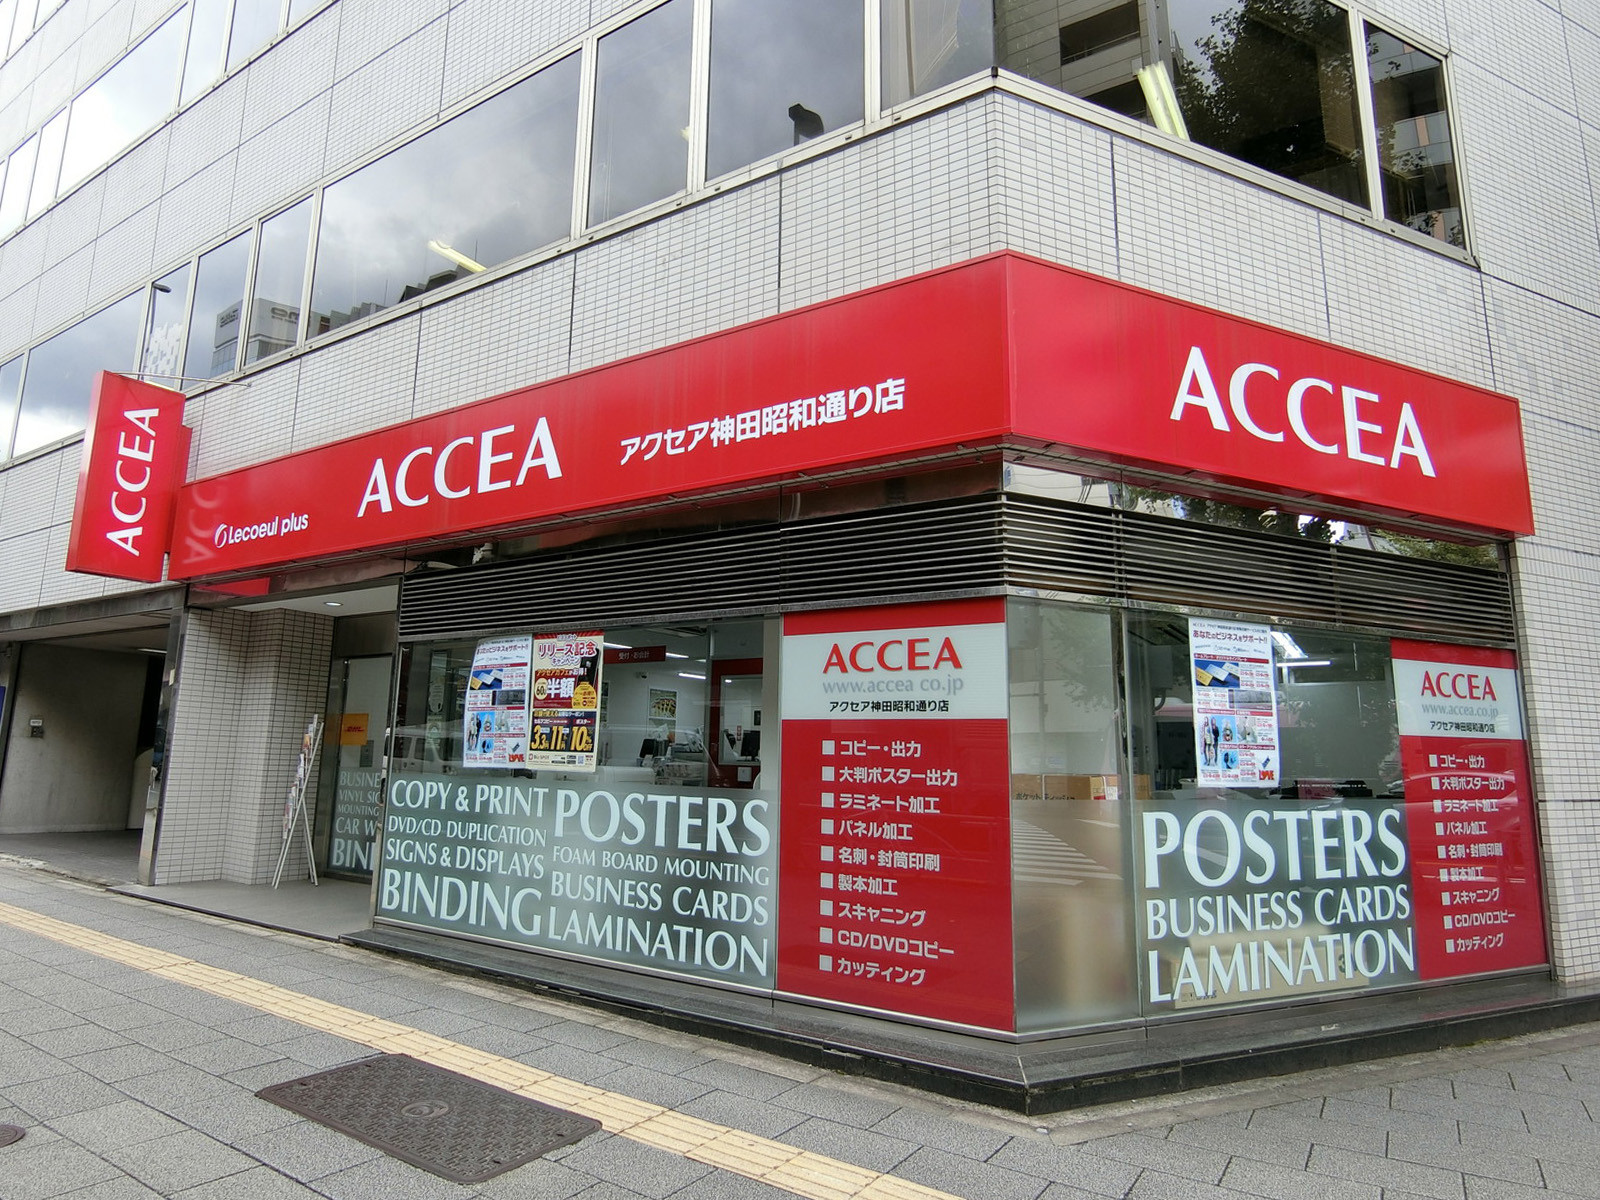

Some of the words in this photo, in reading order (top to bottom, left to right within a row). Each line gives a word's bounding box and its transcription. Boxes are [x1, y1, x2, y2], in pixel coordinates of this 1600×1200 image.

[620, 378, 906, 466] アクセア神田昭和通り店
[1169, 345, 1437, 478] ACCEA
[357, 416, 562, 519] ACCEA
[107, 408, 159, 556] ACCEA
[228, 517, 278, 545] Lecoeul
[281, 512, 309, 537] plus
[538, 641, 597, 658] リリース記念
[822, 636, 963, 675] ACCEA
[547, 677, 575, 699] 半額
[1421, 670, 1497, 701] ACCEA
[829, 699, 950, 713] アクセア神田昭和通り店
[1421, 703, 1499, 719] www.accea.co.jp
[1430, 721, 1495, 733] アクセア神田昭和通り店
[840, 739, 922, 758] コピー・出力
[1440, 754, 1485, 768] コピー・出力
[839, 766, 958, 787] 大判ポスター出力
[1442, 776, 1505, 791] 大判ポスター出力
[339, 789, 364, 804] VINYL
[391, 779, 453, 810] COPY
[455, 786, 470, 812] &
[475, 785, 549, 818] PRINT
[839, 793, 940, 815] ラミネート加工
[1444, 799, 1499, 813] ラミネート加工
[338, 804, 379, 817] MOUNTING
[336, 816, 360, 835] CAR
[388, 815, 442, 836] DVD/CD
[447, 820, 547, 847] DUPLICATION
[554, 789, 771, 857] POSTERS
[838, 820, 913, 841] パネル加工
[1446, 821, 1488, 835] パネル加工
[386, 838, 437, 866] SIGNS
[440, 846, 452, 867] &
[456, 845, 544, 880] DISPLAYS
[838, 846, 940, 872] 名刺・封筒印刷
[1143, 807, 1407, 889] POSTERS
[1448, 843, 1503, 858] 名刺・封筒印刷
[552, 845, 596, 866] FOAM
[602, 851, 658, 873] BOARD
[664, 859, 769, 887] MOUNTING
[1449, 867, 1485, 882] 製本加工
[837, 873, 898, 896] 製本加工
[1453, 888, 1500, 905] スキャニング
[381, 868, 542, 937] BINDING
[550, 870, 662, 911] BUSINESS
[672, 886, 769, 927] CARDS
[837, 901, 926, 927] スキャニング
[1147, 891, 1304, 940] BUSINESS
[1314, 883, 1411, 926] CARDS
[1455, 909, 1515, 928] CD/DVDコピー
[548, 905, 768, 977] LAMINATION
[837, 929, 954, 959] CD/DVDコピー
[1457, 933, 1504, 952] カッティング
[837, 957, 926, 986] カッティング
[1148, 925, 1415, 1003] LAMINATION
